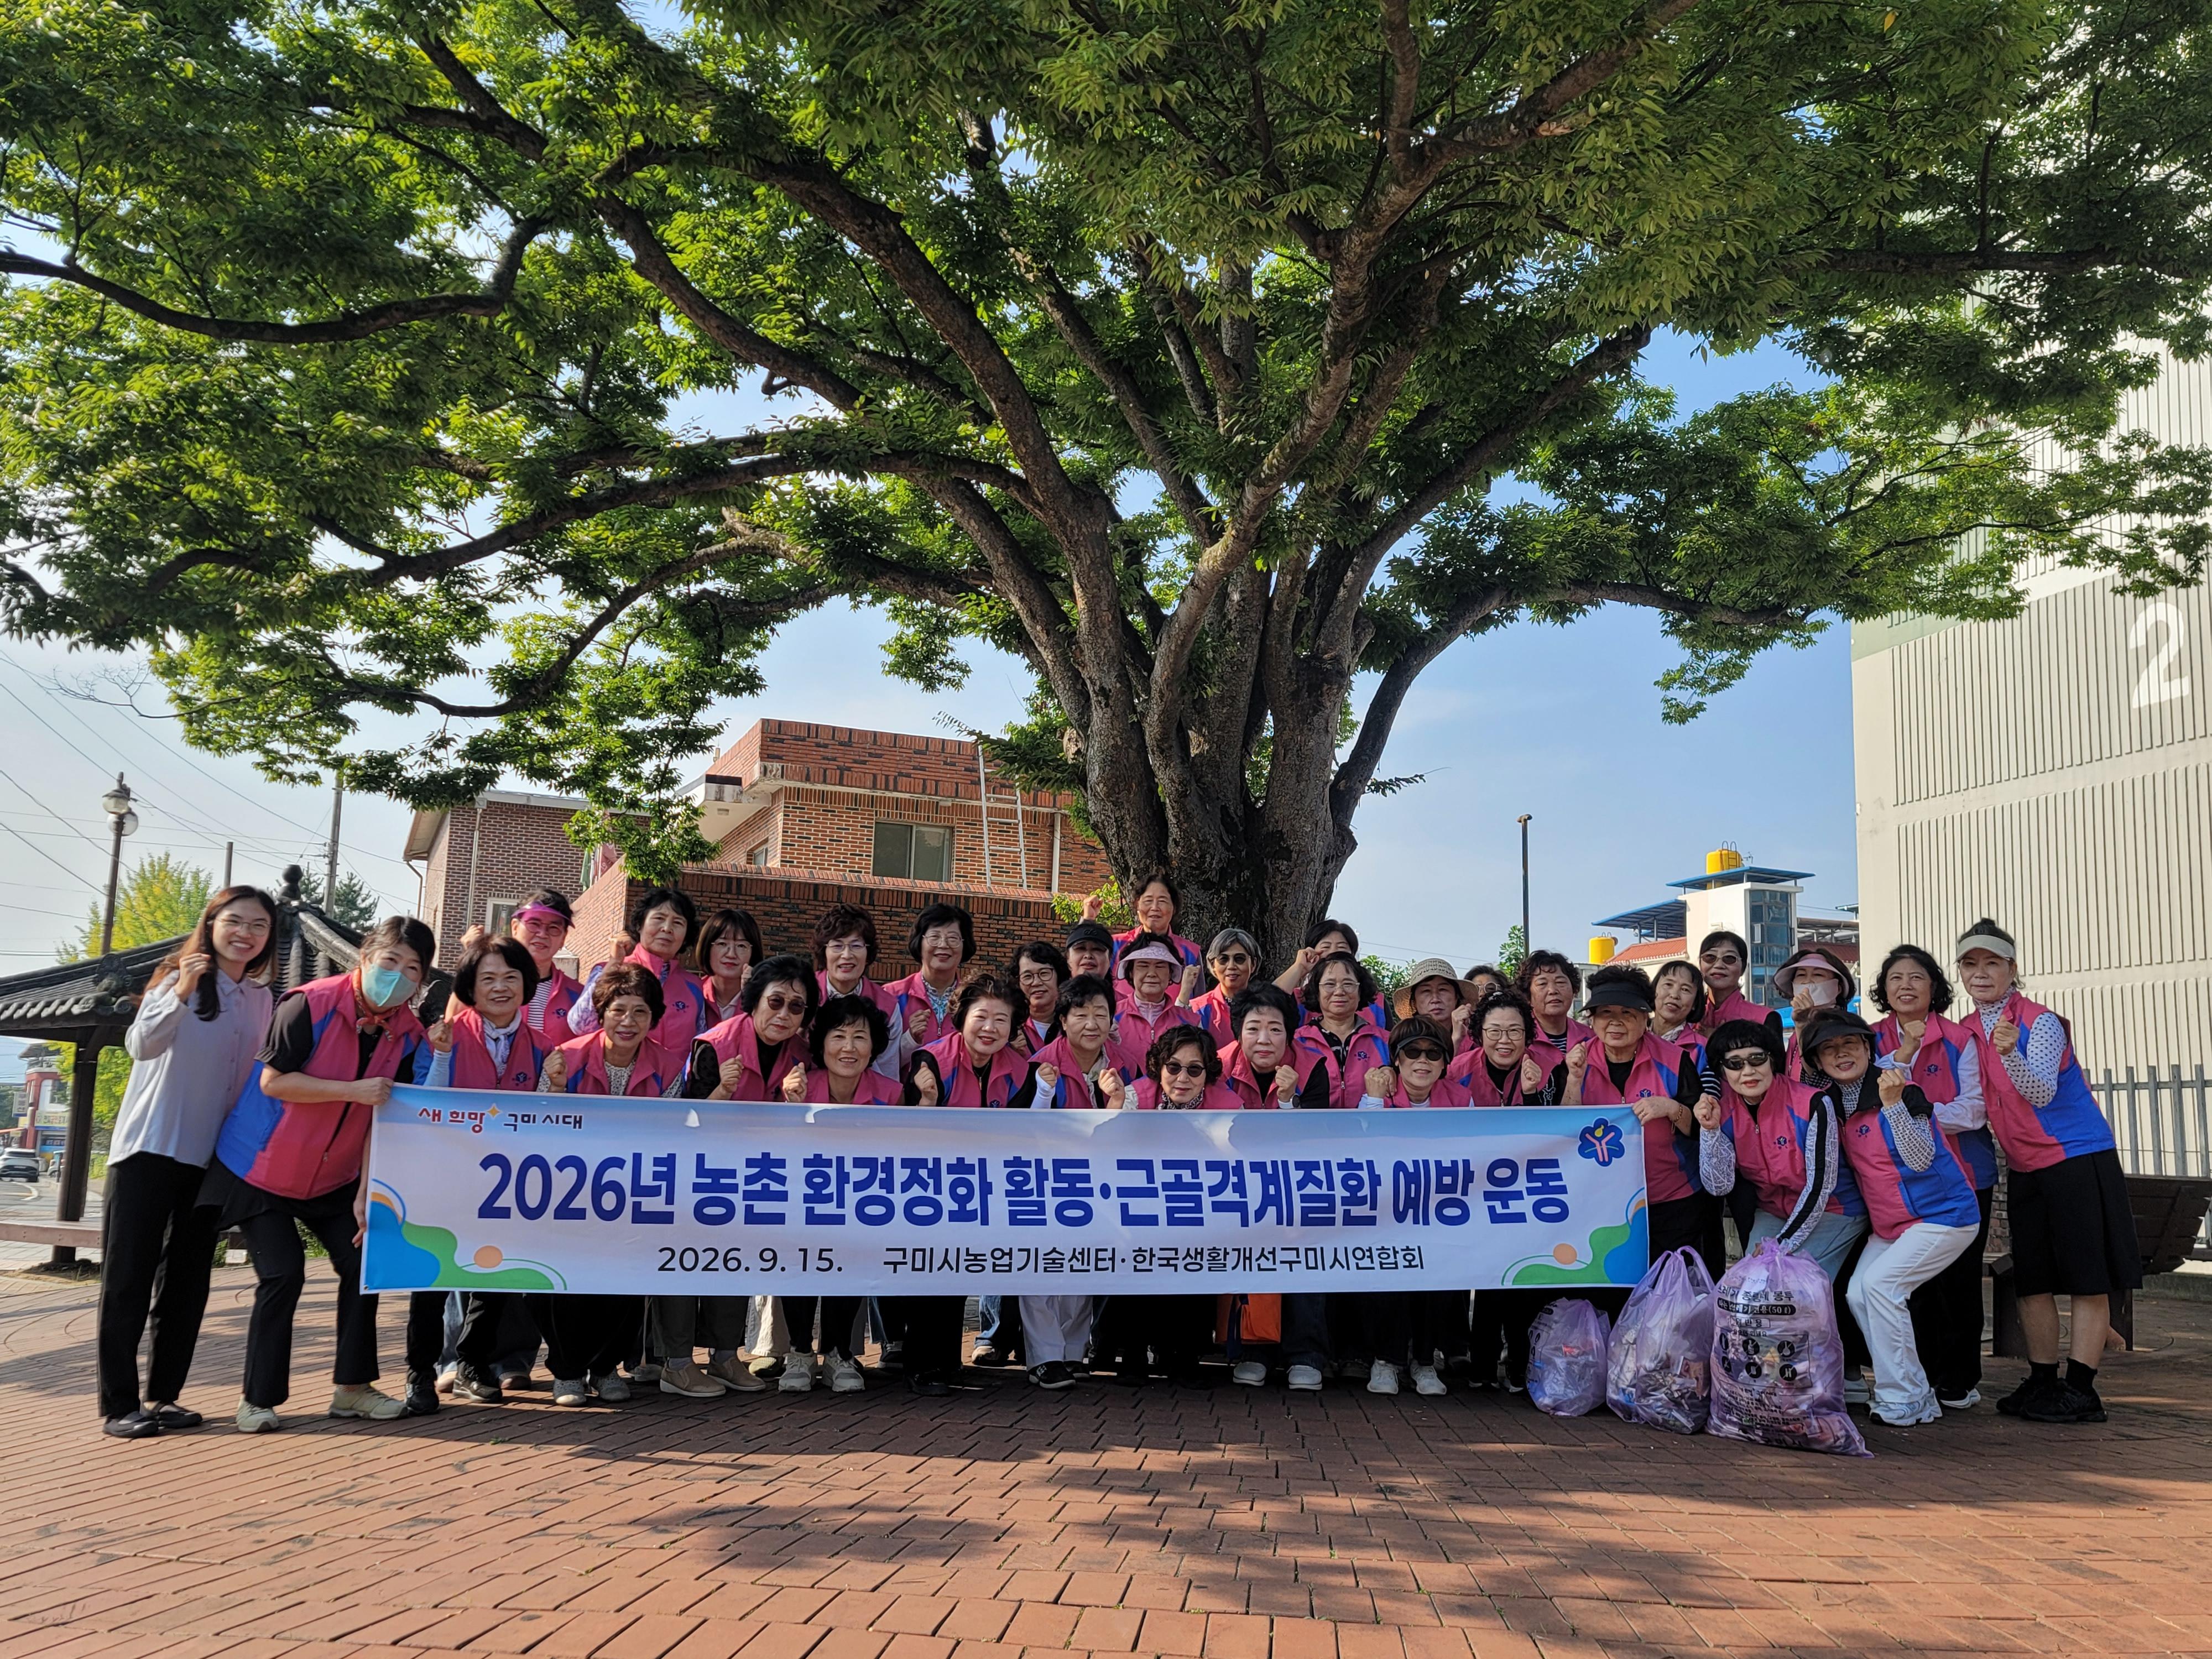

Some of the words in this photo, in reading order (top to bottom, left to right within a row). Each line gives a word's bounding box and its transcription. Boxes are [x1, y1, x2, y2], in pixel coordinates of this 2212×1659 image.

[2129, 602, 2189, 708] 2
[418, 1108, 442, 1123] 새
[448, 1110, 486, 1134] 희망
[503, 1113, 537, 1132] 구미
[541, 1114, 583, 1129] 시대
[477, 1152, 676, 1225] 2026년
[692, 1152, 789, 1226] 농촌
[803, 1153, 993, 1227] 환경정화
[1392, 1159, 1475, 1226] 예방
[1483, 1158, 1569, 1224] 운동
[1773, 1290, 1794, 1301] 봉투
